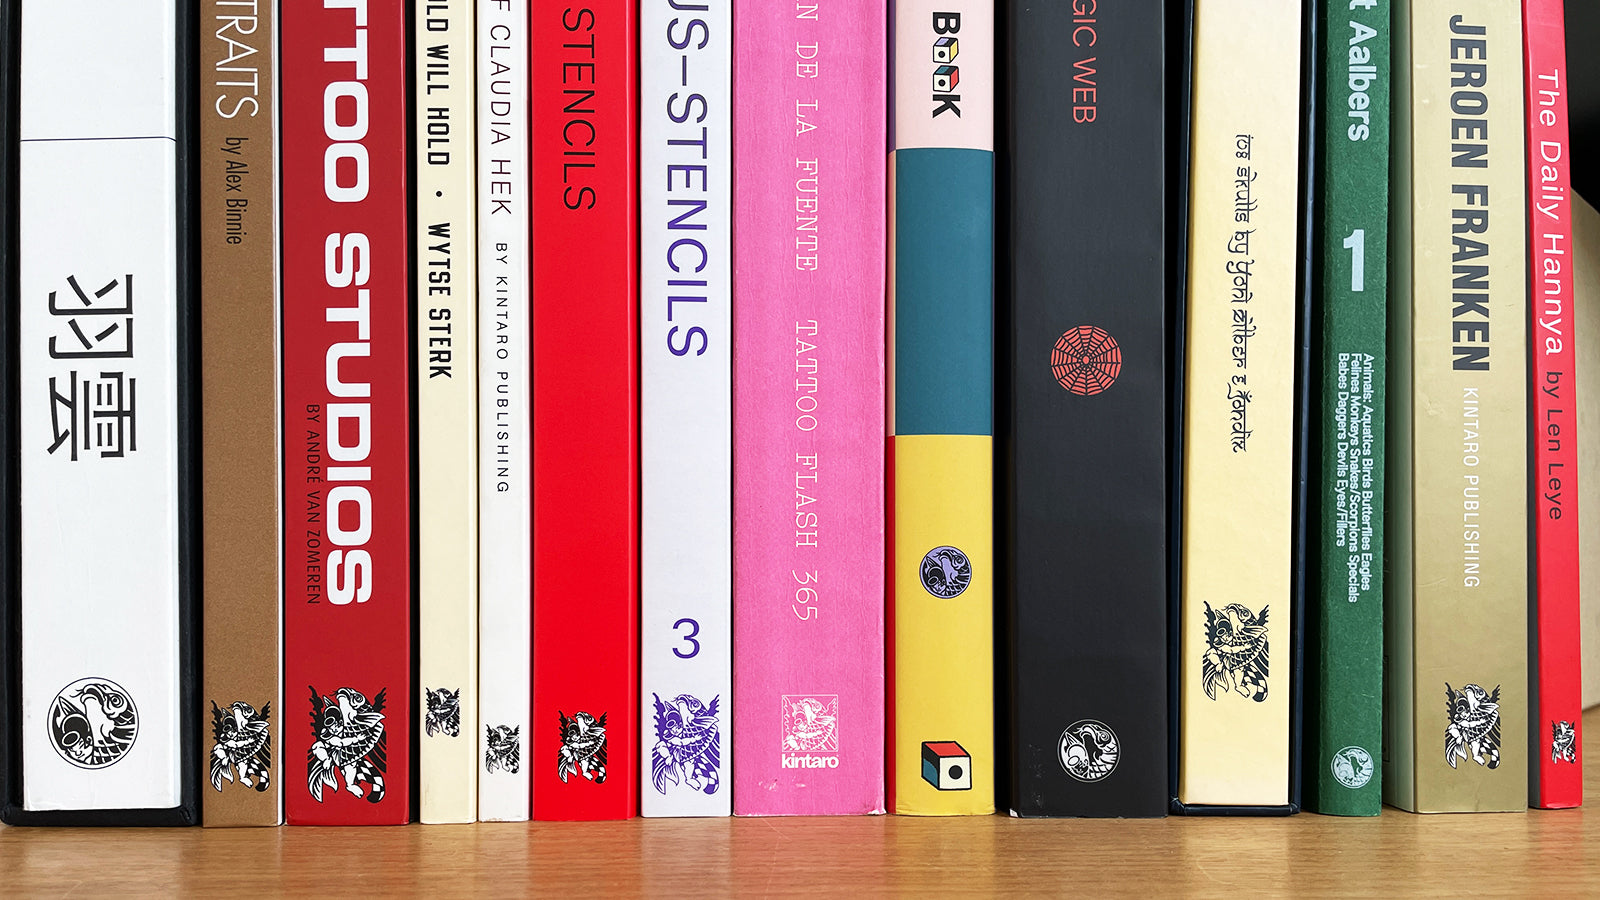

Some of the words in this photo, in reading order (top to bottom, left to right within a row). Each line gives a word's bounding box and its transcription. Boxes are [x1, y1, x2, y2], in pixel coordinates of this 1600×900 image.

[427, 0, 448, 31] LD
[427, 45, 449, 95] WILL
[491, 25, 510, 144] CLAUDIA
[795, 42, 819, 79] DE
[1348, 21, 1377, 141] Aalbers
[563, 8, 595, 209] STENCILS
[1073, 58, 1096, 123] WEB
[1450, 15, 1488, 168] JEROEN
[1539, 69, 1560, 127] The
[428, 108, 449, 165] HOLD
[795, 100, 819, 137] LA
[221, 137, 248, 156] by
[225, 160, 248, 192] Alex
[492, 160, 511, 214] HEK
[1536, 141, 1563, 220] Daily
[225, 198, 248, 245] Binnie
[795, 158, 819, 271] FUENTE
[428, 223, 450, 296] WYTSE
[496, 243, 507, 264] BY
[1228, 229, 1256, 256] by
[1344, 228, 1364, 291] 1
[1452, 185, 1489, 371] FRANKEN
[1537, 234, 1564, 355] Hannya
[429, 309, 451, 378] STERK
[497, 277, 508, 359] KINTARO
[795, 320, 818, 432] TATTOO
[1338, 353, 1349, 389] Babes
[1351, 353, 1362, 393] Felines
[1362, 353, 1375, 403] Animals:
[1543, 372, 1562, 398] by
[307, 405, 320, 422] BY
[324, 232, 372, 605] STUDIOS
[497, 372, 508, 491] PUBLISHING
[1335, 391, 1349, 440] Daggers
[1348, 395, 1361, 445] Monkeys
[1361, 405, 1374, 455] Aquatics
[1464, 388, 1479, 466] KINTARO
[1548, 410, 1562, 451] Len
[307, 431, 323, 483] ANDRÉ
[1337, 442, 1349, 477] Devils
[1362, 458, 1373, 488] Birds
[307, 491, 320, 522] VAN
[795, 452, 818, 548] FLASH
[1335, 480, 1348, 547] Eyes/Fillers
[1348, 448, 1361, 552] Snakes/Scorpions
[1545, 464, 1563, 519] Leye
[1361, 491, 1373, 550] Butterflies
[1463, 476, 1479, 586] PUBLISHING
[307, 530, 320, 603] ZOMEREN
[1347, 555, 1360, 603] Specials
[1359, 553, 1372, 591] Eagles
[792, 570, 819, 621] 365
[673, 618, 700, 658] 3
[782, 754, 840, 769] kintaro
